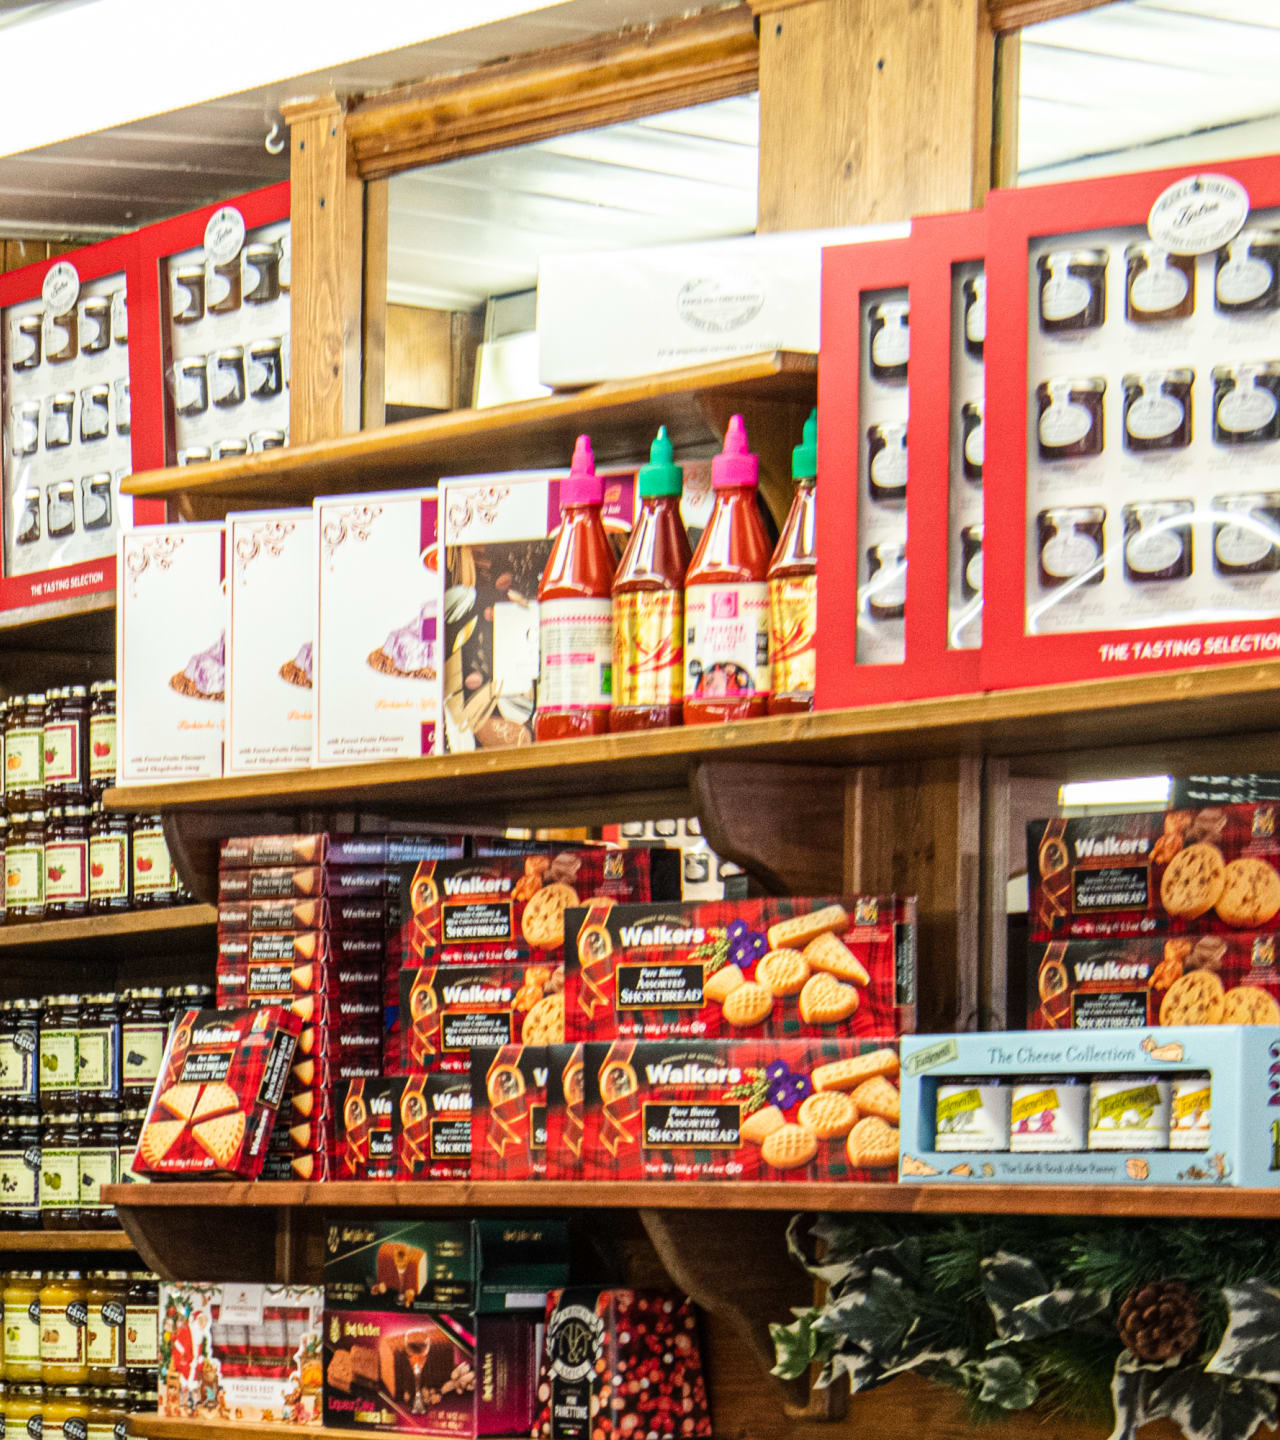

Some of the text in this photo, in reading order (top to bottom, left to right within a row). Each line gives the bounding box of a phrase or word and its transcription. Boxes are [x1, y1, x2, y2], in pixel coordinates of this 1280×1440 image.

[31, 571, 104, 596] THE TASTING SELECTION
[1099, 643, 1130, 662] THE
[1132, 638, 1202, 661] TASTING
[342, 843, 381, 854] Walkers
[1074, 837, 1149, 857] Walkers
[341, 877, 379, 887] Walkers
[444, 876, 511, 895] Walkers
[342, 908, 380, 919] Walkers
[446, 924, 508, 937] SHORTBREAD
[619, 926, 705, 946] Walkers
[1074, 961, 1149, 981] Walkers
[636, 978, 686, 989] ASSORTED
[443, 986, 511, 1004] Walkers
[620, 989, 703, 1004] SHORTBREAD
[192, 1029, 241, 1045] Walkers
[340, 1036, 379, 1046] Walkers
[989, 1045, 1136, 1064] The Cheese Collection
[646, 1064, 741, 1084] Walkers
[433, 1092, 471, 1111] Walk
[665, 1117, 720, 1128] ASSORTED
[647, 1128, 739, 1142] SHORTBREAD
